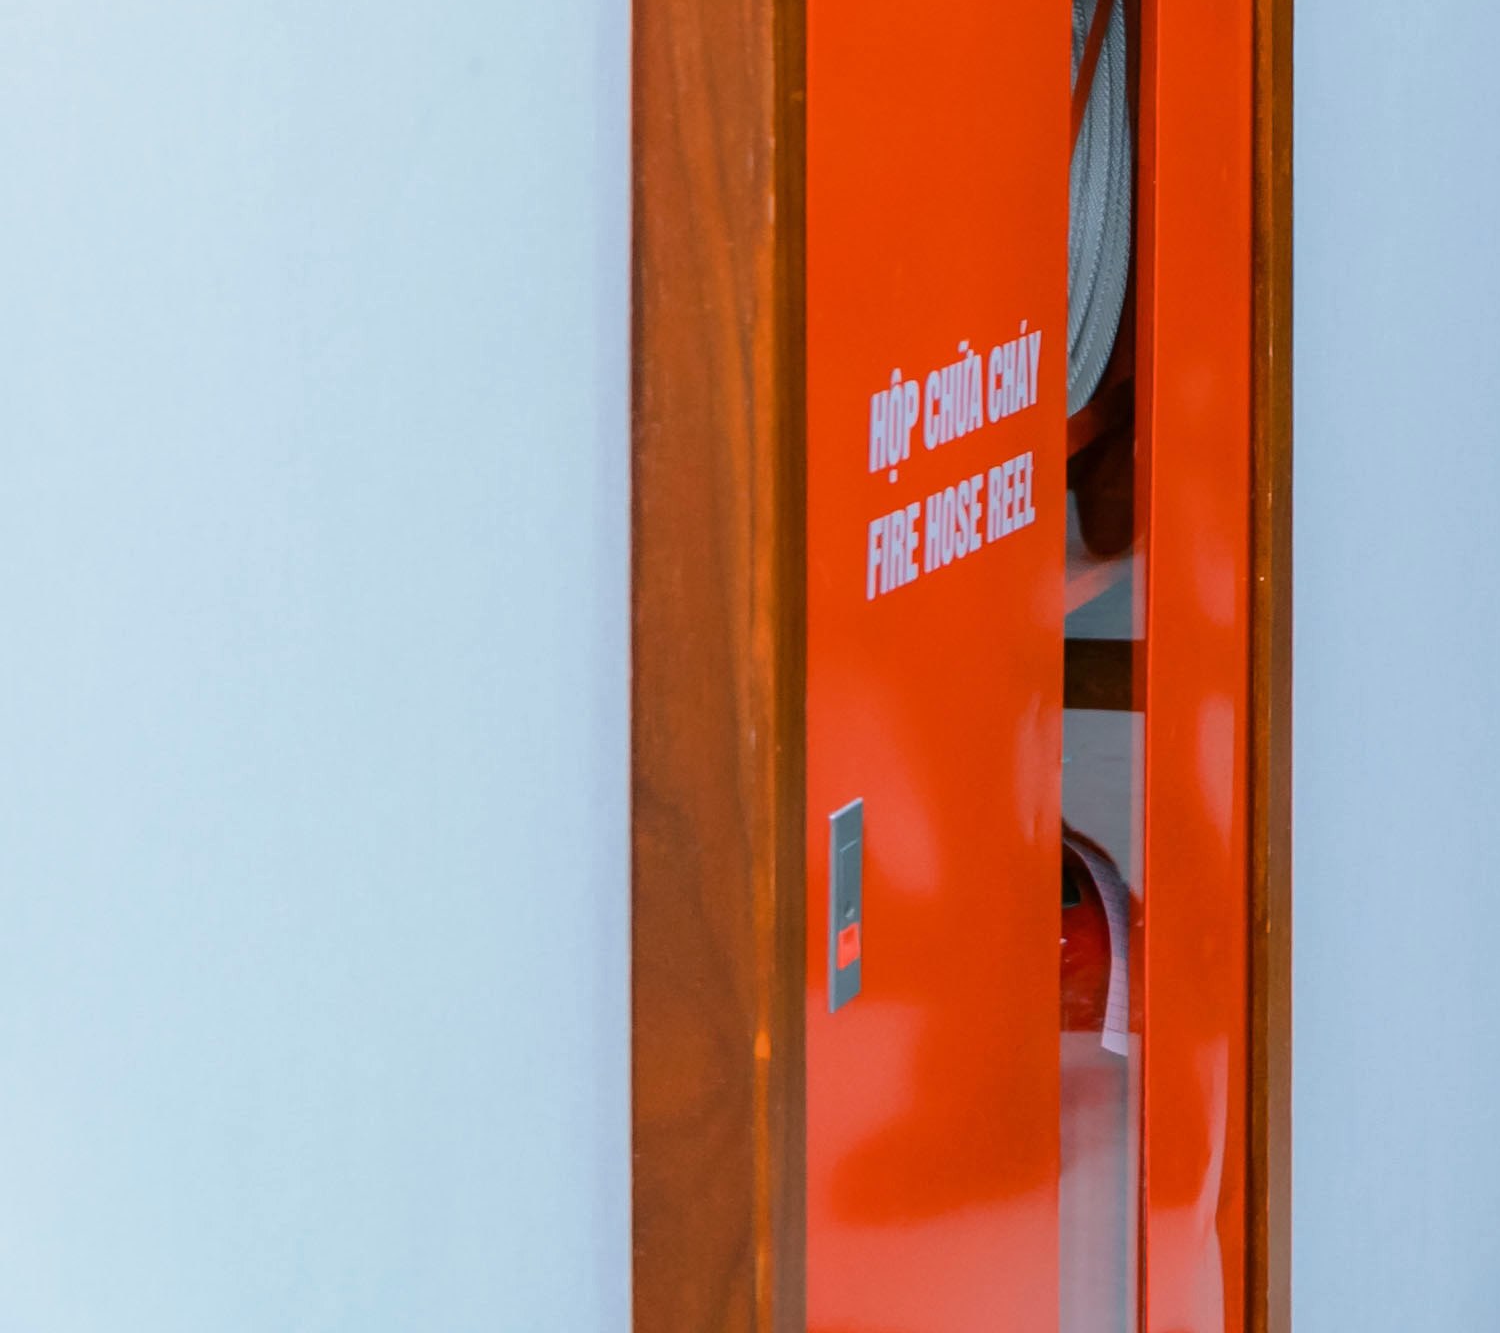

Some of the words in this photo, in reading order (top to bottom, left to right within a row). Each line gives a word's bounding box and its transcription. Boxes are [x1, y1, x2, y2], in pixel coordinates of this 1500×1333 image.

[869, 366, 921, 484] HỘP
[922, 337, 984, 451] CHỮA
[987, 318, 1042, 425] CHÁY
[866, 500, 921, 601] FIRE
[924, 472, 984, 574] HOSE
[986, 449, 1036, 544] REEL
